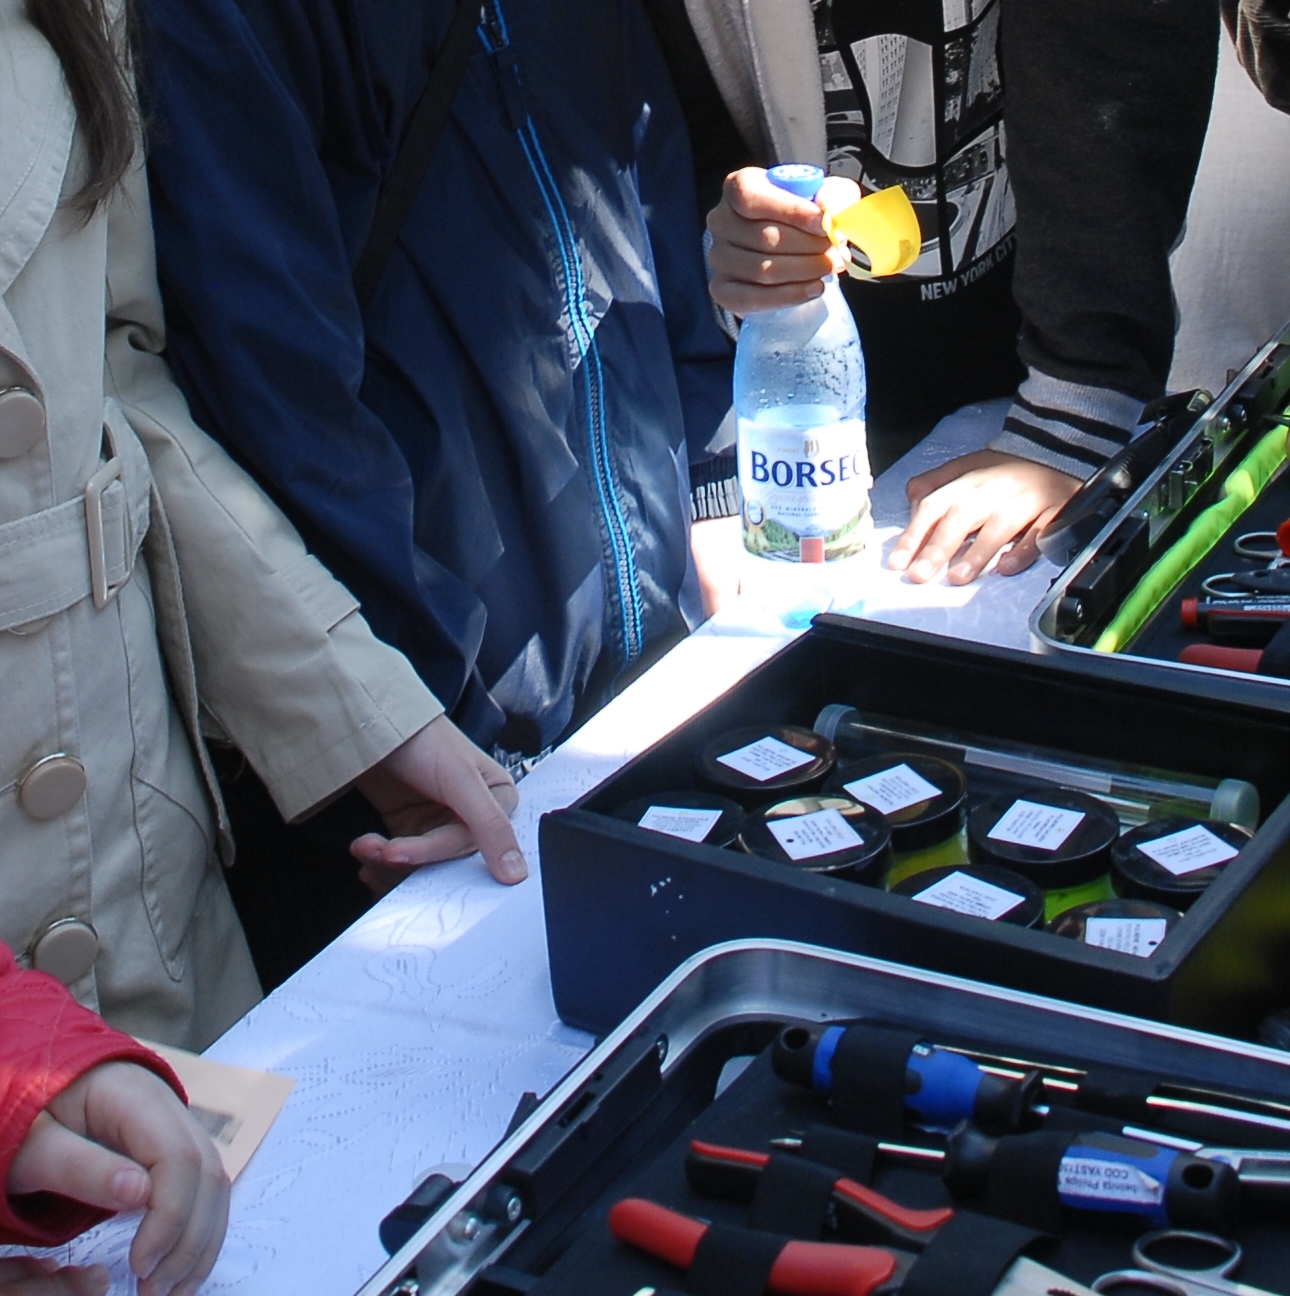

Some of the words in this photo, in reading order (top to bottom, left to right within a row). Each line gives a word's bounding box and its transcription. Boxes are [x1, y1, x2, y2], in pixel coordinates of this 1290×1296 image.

[920, 278, 958, 301] NEW
[960, 253, 994, 287] YORK
[1104, 1167, 1130, 1180] COD
